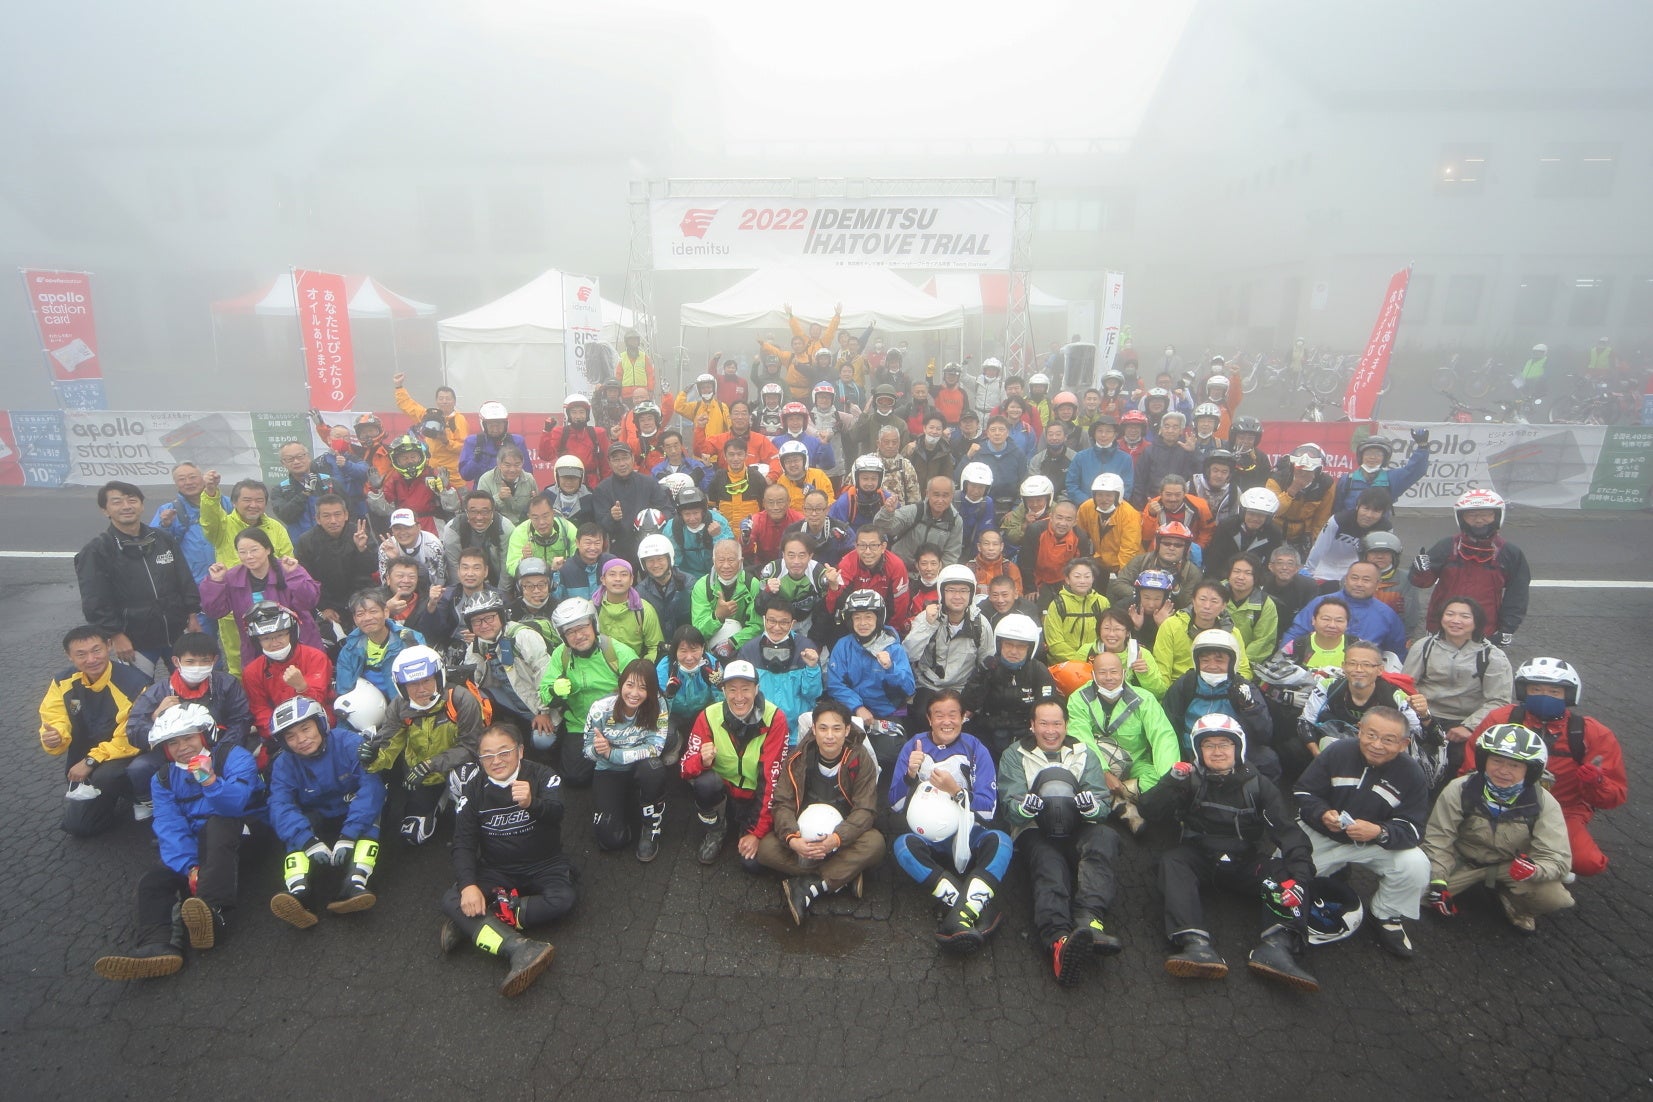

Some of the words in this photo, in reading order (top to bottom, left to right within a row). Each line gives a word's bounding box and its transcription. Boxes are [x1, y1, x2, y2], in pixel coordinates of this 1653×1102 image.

[738, 208, 808, 230] 2022
[810, 208, 938, 230] IDEMITSU
[672, 241, 730, 255] idemitsu
[811, 233, 916, 254] HATOVE
[920, 233, 991, 255] TRIAL
[38, 291, 85, 305] apollo
[41, 303, 86, 315] station
[44, 313, 71, 325] card
[306, 288, 328, 384] オイルあります。
[324, 289, 344, 401] あなたにぴったりの
[72, 418, 144, 441] apollo
[76, 441, 150, 458] station
[79, 461, 170, 477] BUSINESS
[1405, 480, 1479, 499] SINESS
[367, 845, 378, 857] G
[286, 856, 297, 869] G
